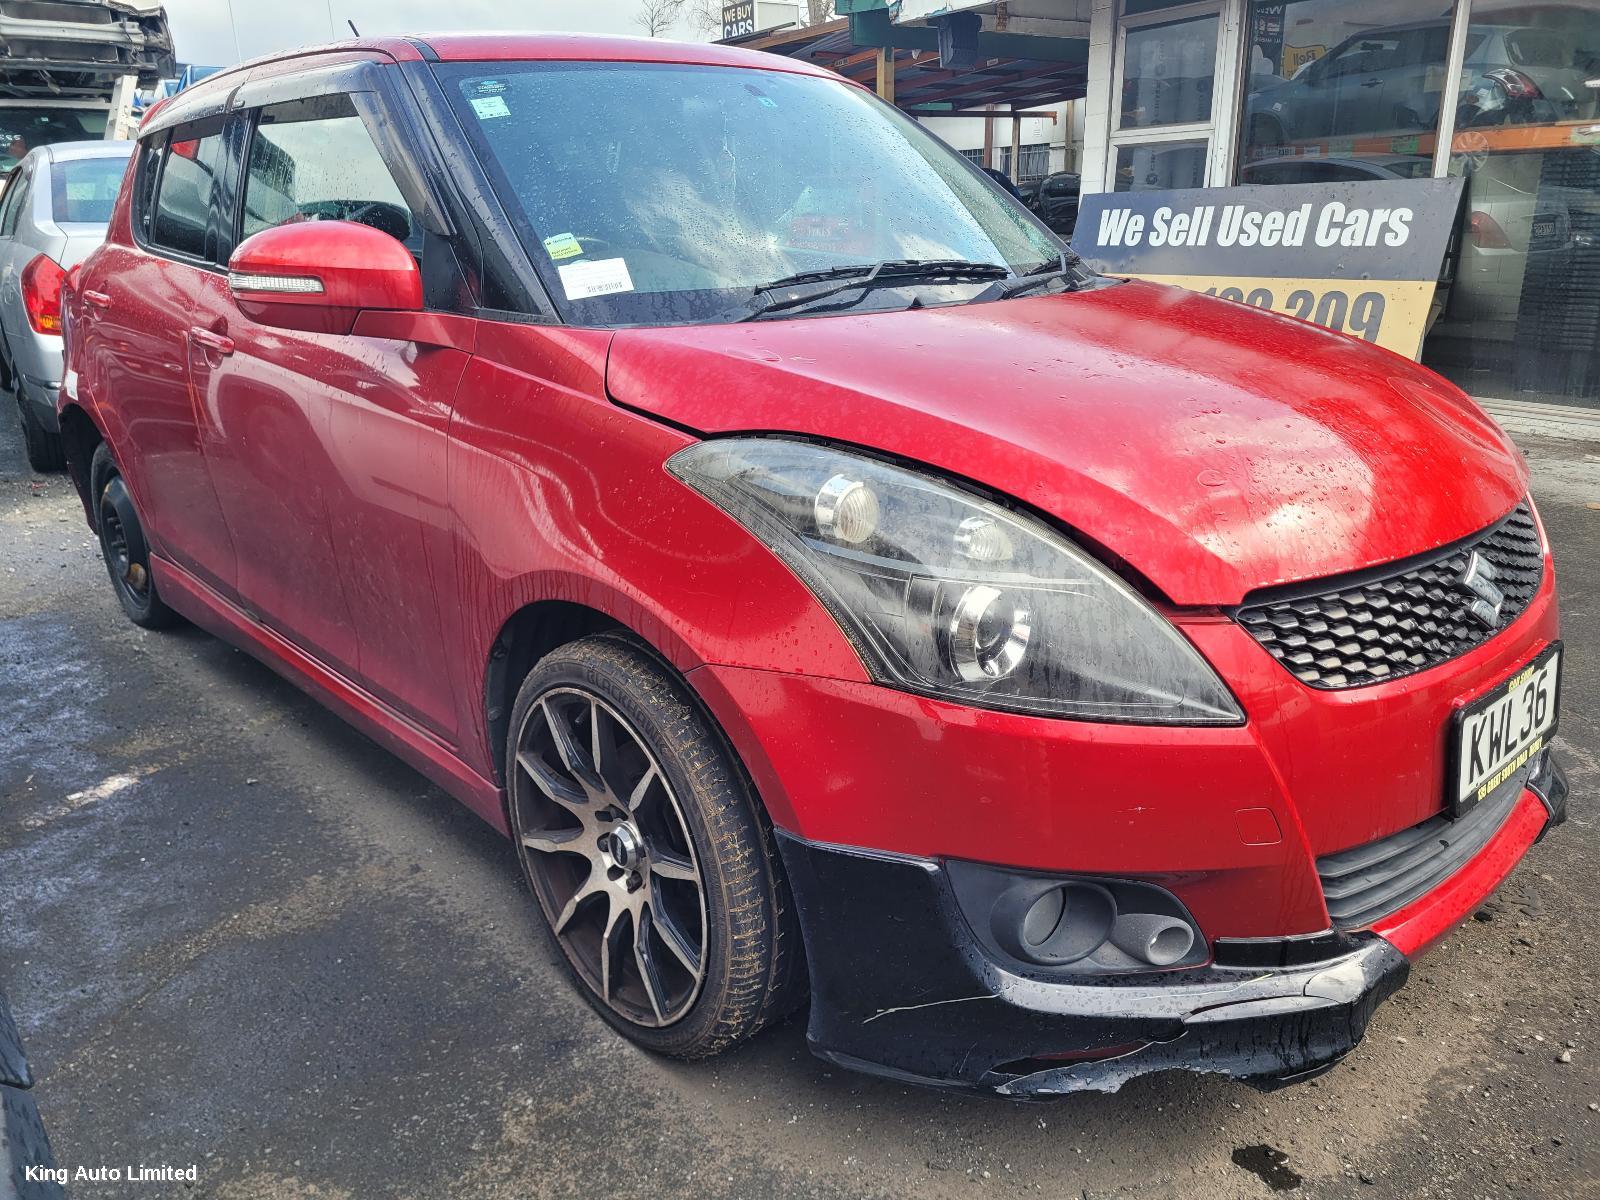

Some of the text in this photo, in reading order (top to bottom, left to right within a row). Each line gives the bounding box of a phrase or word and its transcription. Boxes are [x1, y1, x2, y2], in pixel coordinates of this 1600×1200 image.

[724, 4, 752, 23] WE BUY
[724, 19, 753, 38] CARS
[1097, 202, 1413, 247] We Sell Used Cars
[1468, 669, 1548, 785] KWL36
